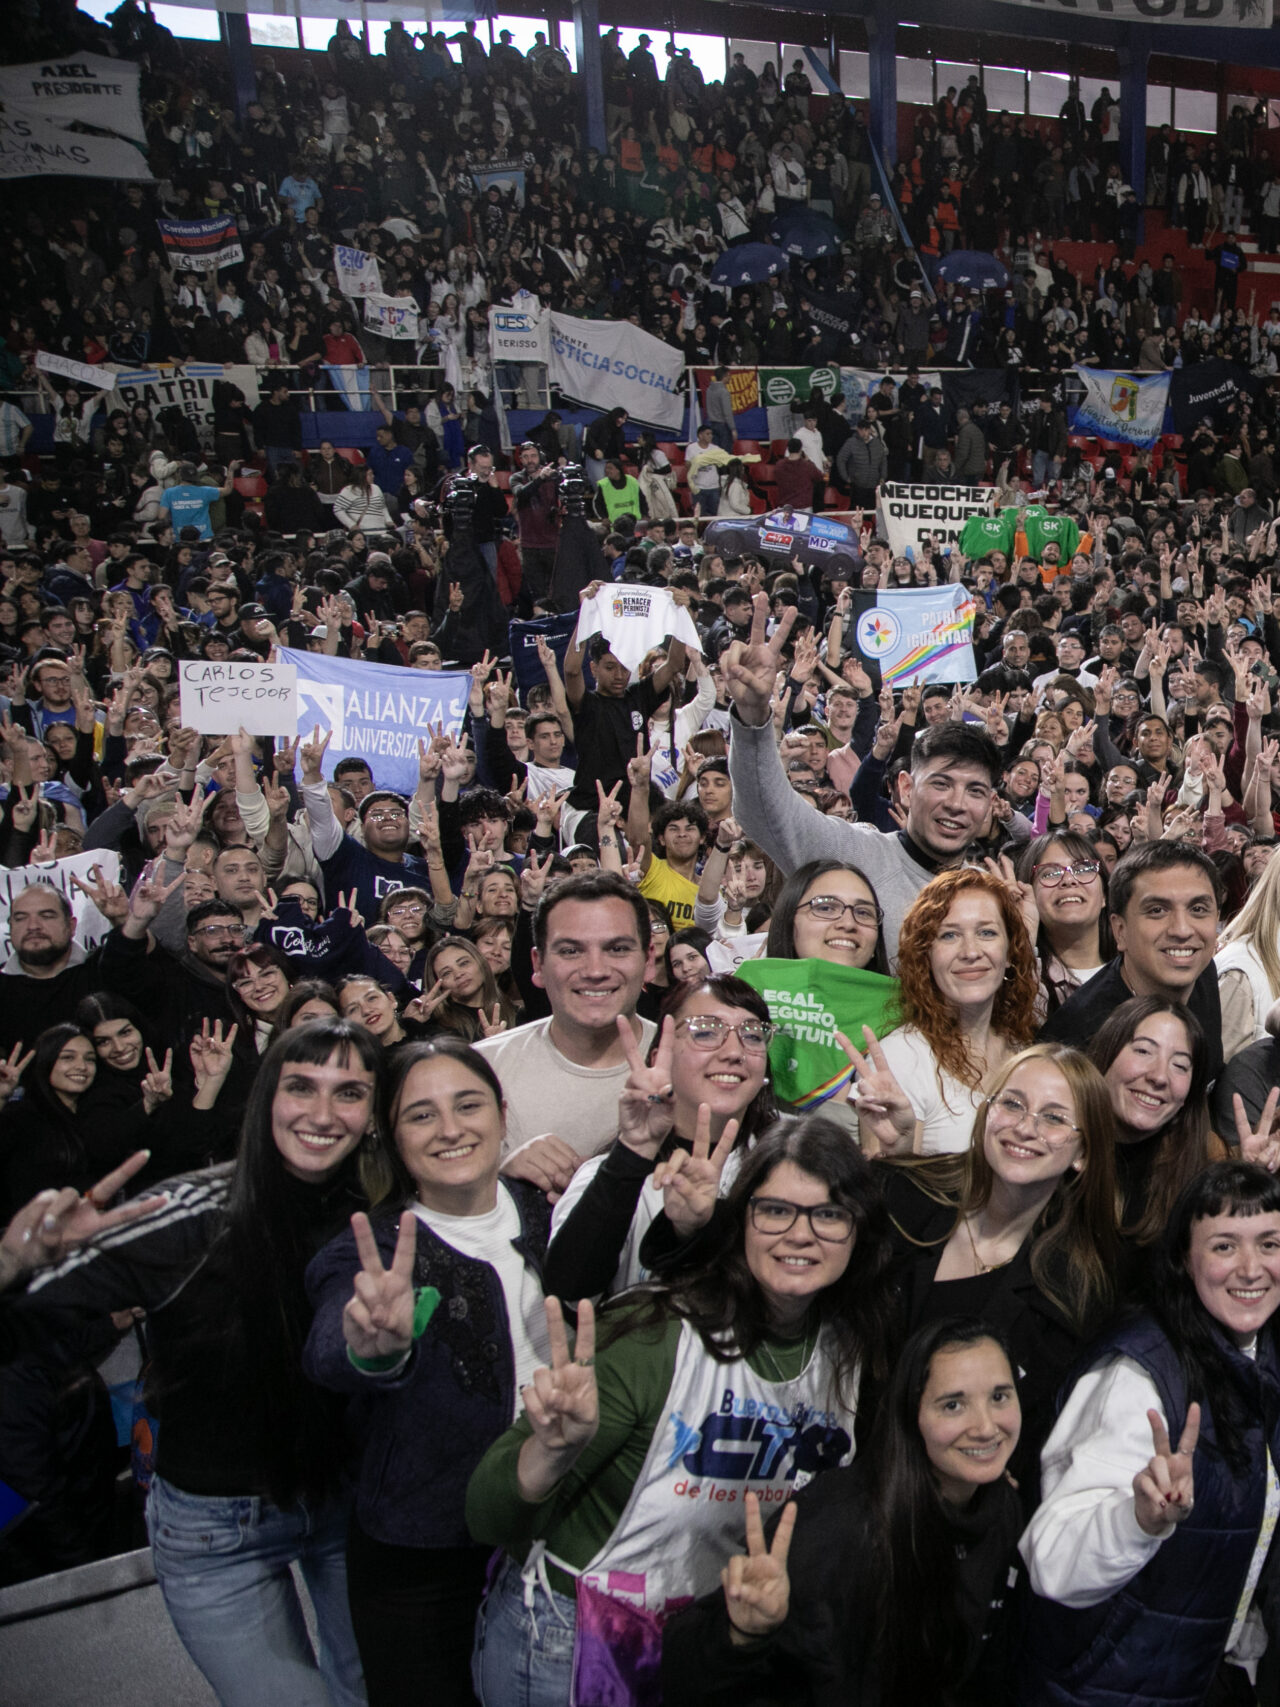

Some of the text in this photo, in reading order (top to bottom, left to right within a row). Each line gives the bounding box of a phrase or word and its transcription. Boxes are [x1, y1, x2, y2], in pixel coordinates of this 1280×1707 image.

[41, 64, 96, 78] AXEL
[32, 82, 122, 96] PRESIDENTE
[495, 315, 526, 330] UES
[160, 366, 186, 380] LA
[612, 359, 675, 394] SOCIAL
[623, 598, 652, 607] RENACER
[184, 663, 275, 683] CARLOS
[345, 690, 444, 726] ALIANZA
[674, 1480, 702, 1498] de
[709, 1484, 738, 1501] les
